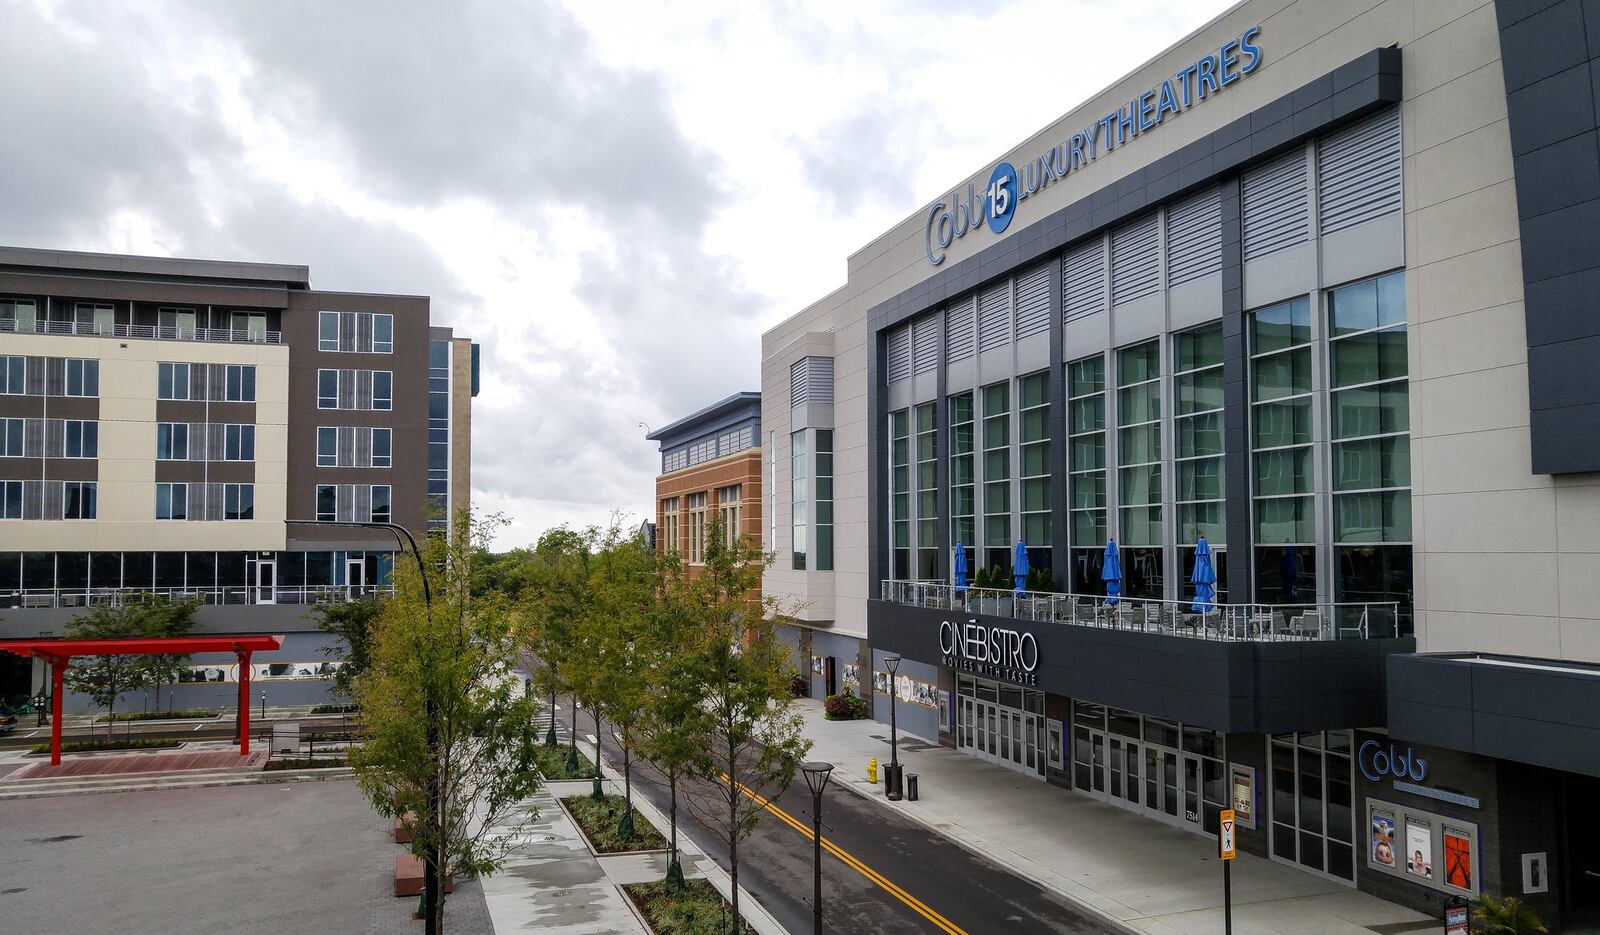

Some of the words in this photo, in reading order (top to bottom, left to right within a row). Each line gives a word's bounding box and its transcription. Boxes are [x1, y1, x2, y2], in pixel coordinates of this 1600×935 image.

[925, 183, 985, 266] Cobb
[987, 175, 1011, 219] 15
[939, 619, 1038, 671] CINÉBISTRO
[977, 664, 1000, 678] WITH
[1005, 669, 1036, 686] TASTE
[1359, 740, 1426, 781] Cobb
